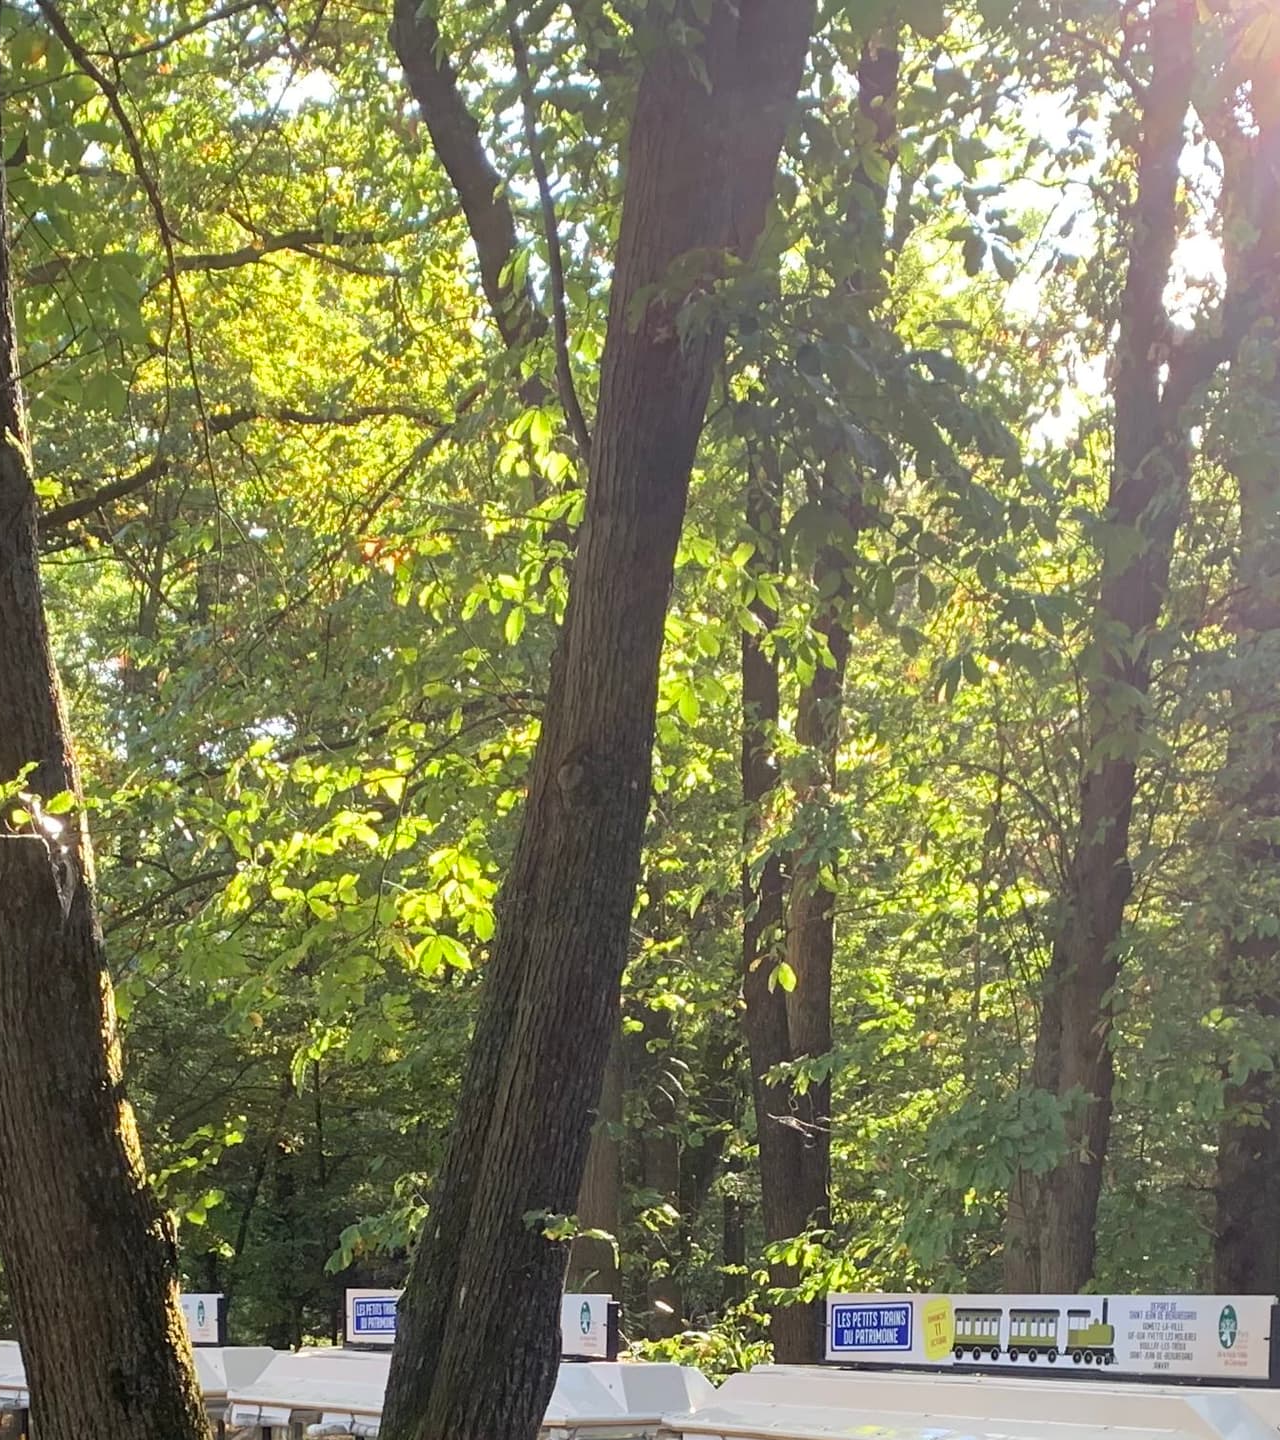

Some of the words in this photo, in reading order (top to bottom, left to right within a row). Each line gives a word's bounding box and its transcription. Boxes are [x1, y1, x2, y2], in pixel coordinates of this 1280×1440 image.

[837, 1312, 851, 1328] LES
[852, 1311, 878, 1327] PETITS
[880, 1310, 906, 1326] TRAINS
[843, 1329, 853, 1344] DU
[855, 1328, 899, 1344] PATRIMOINE
